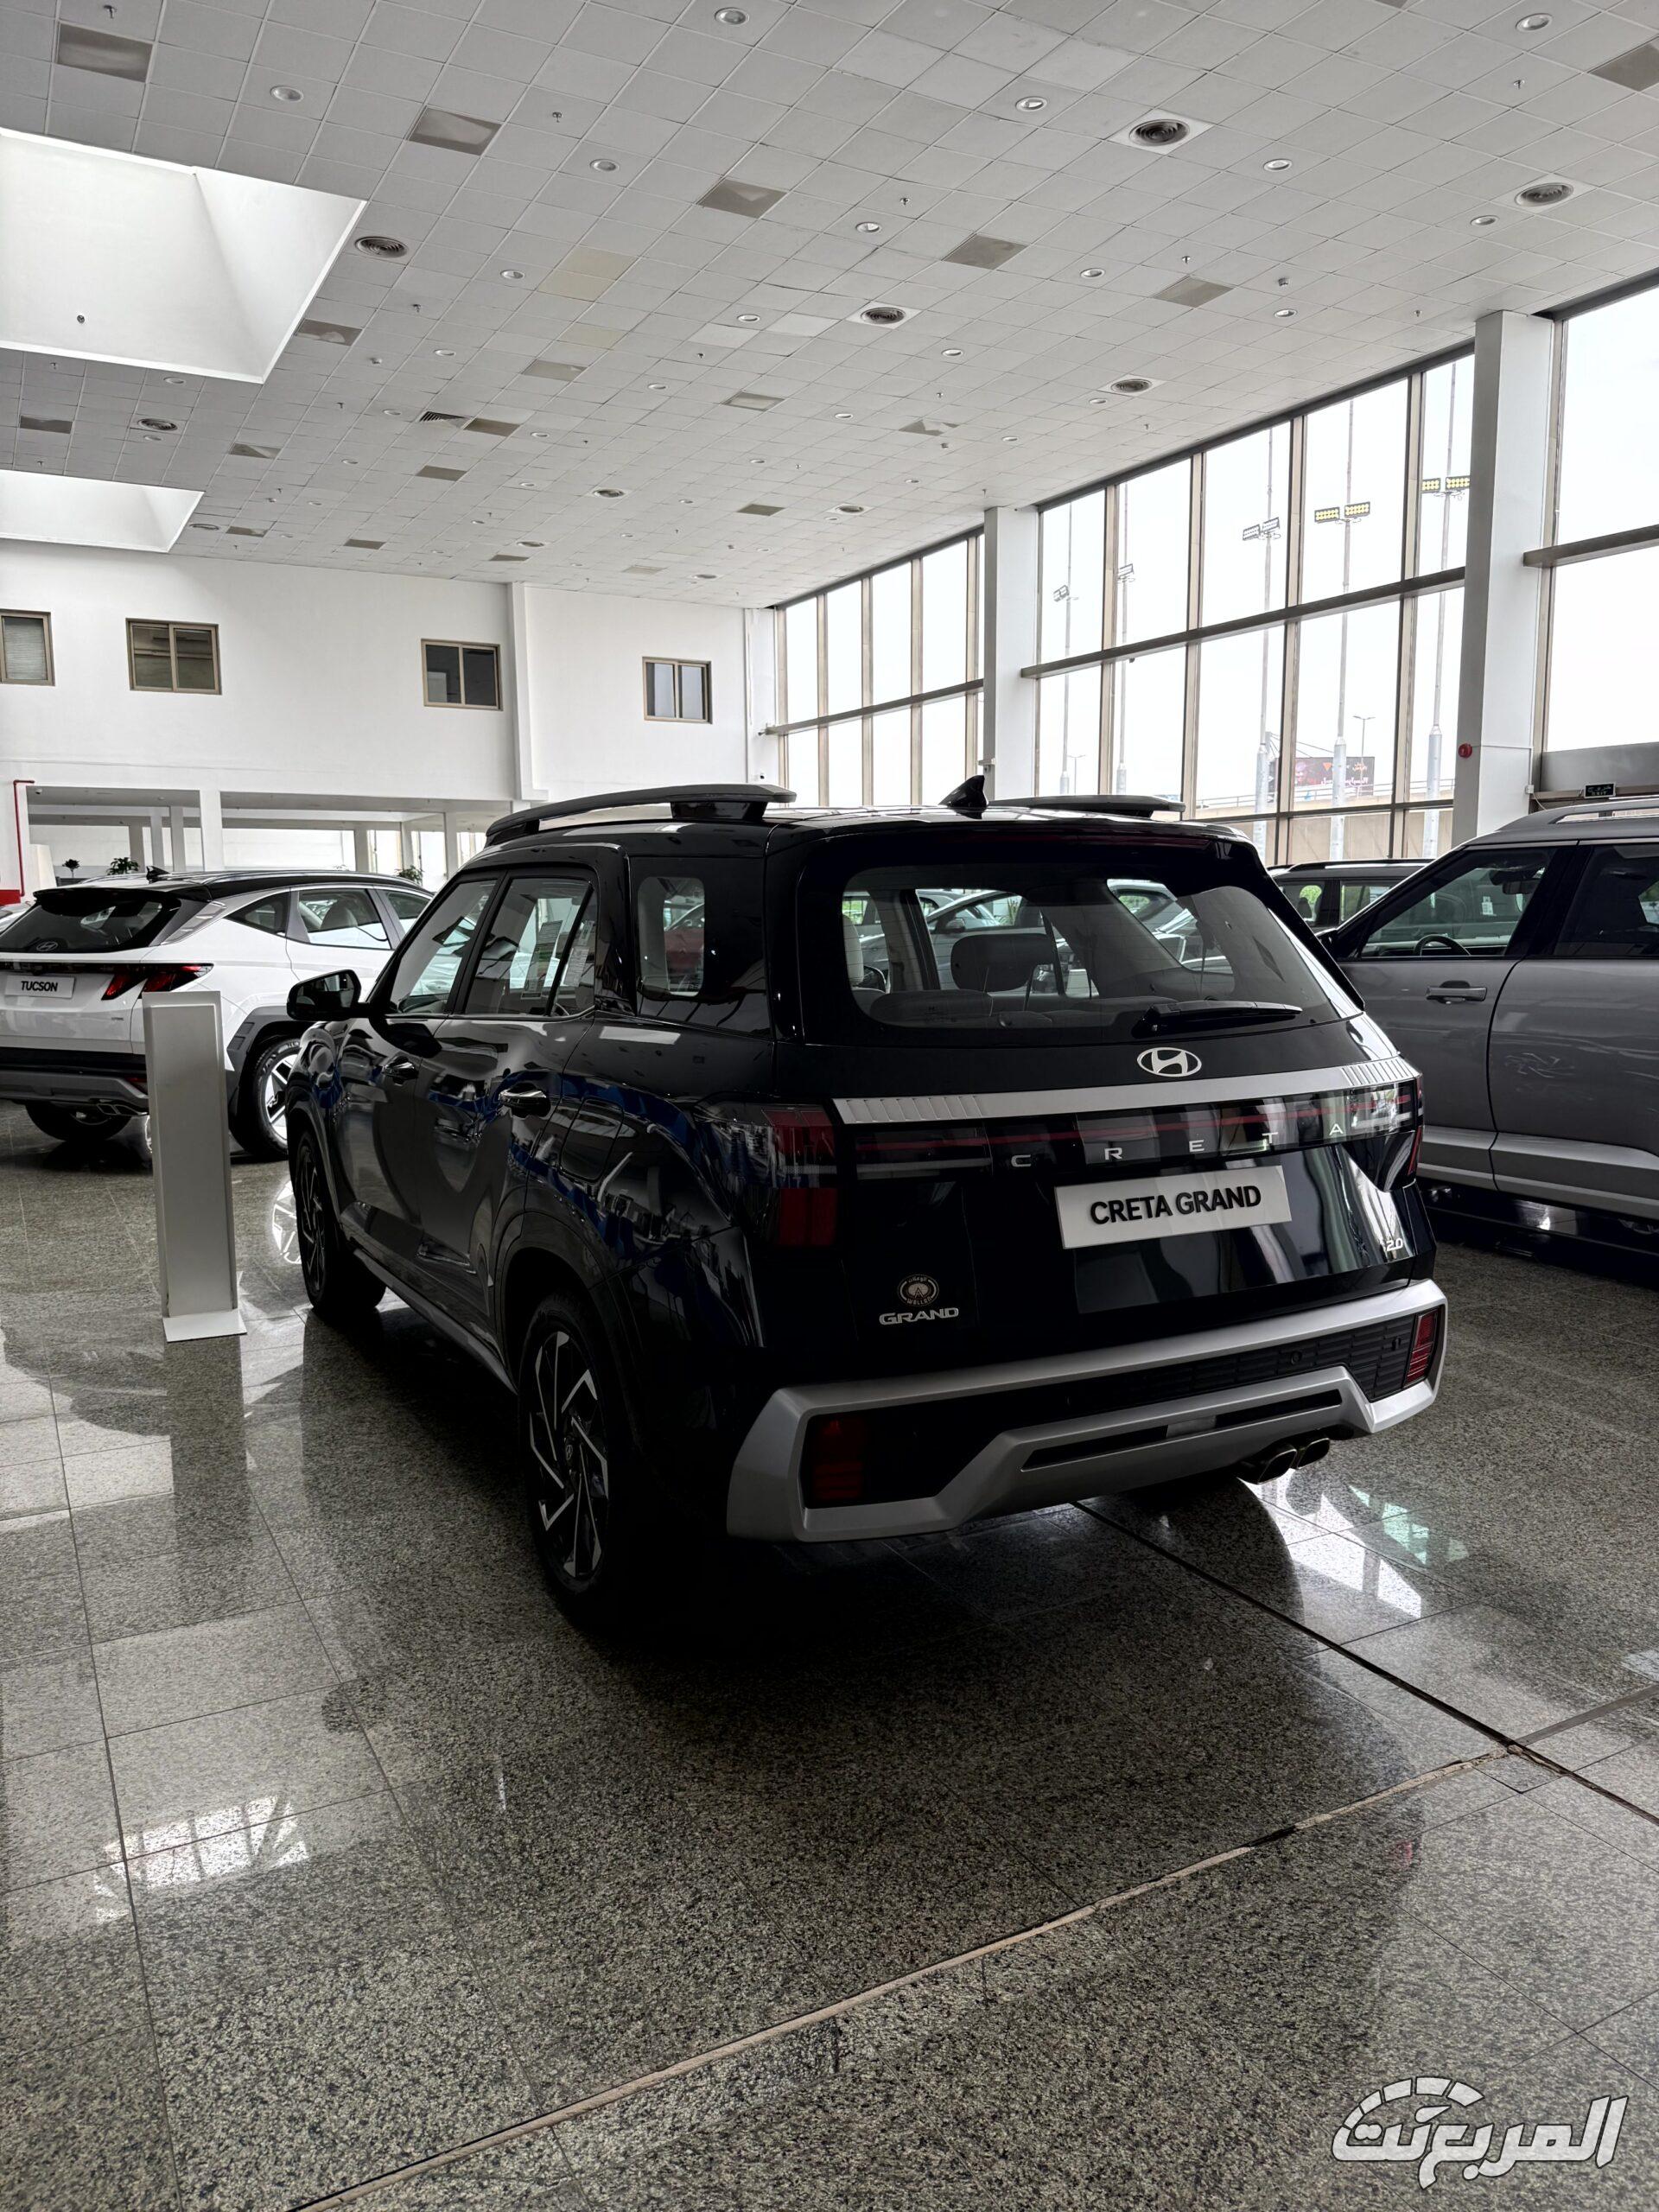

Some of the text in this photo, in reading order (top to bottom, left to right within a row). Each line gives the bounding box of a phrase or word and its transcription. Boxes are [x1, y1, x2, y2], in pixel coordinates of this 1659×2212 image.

[21, 981, 59, 992] TUCSON
[1011, 1123, 1344, 1167] CRETA
[1090, 1185, 1262, 1224] CRETA GRAND
[879, 1307, 959, 1325] GRAND
